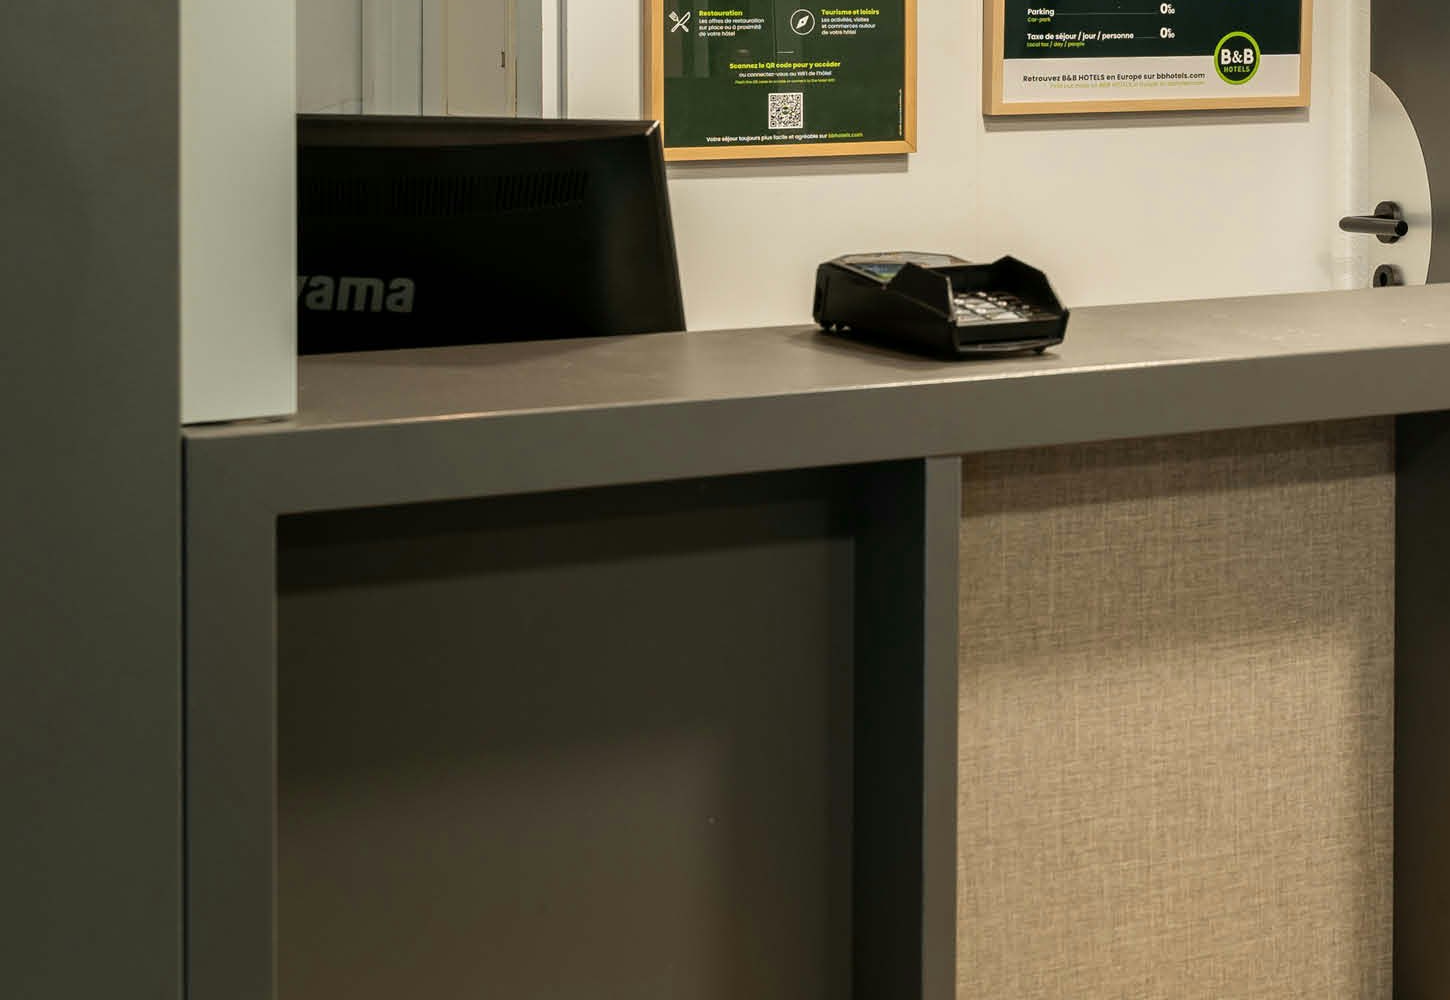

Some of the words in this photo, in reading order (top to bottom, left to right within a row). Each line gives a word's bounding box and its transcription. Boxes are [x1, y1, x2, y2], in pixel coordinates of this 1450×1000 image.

[1027, 8, 1054, 16] Parking
[1055, 32, 1076, 41] séjour
[1082, 32, 1095, 40] jour
[1220, 48, 1254, 64] B&B
